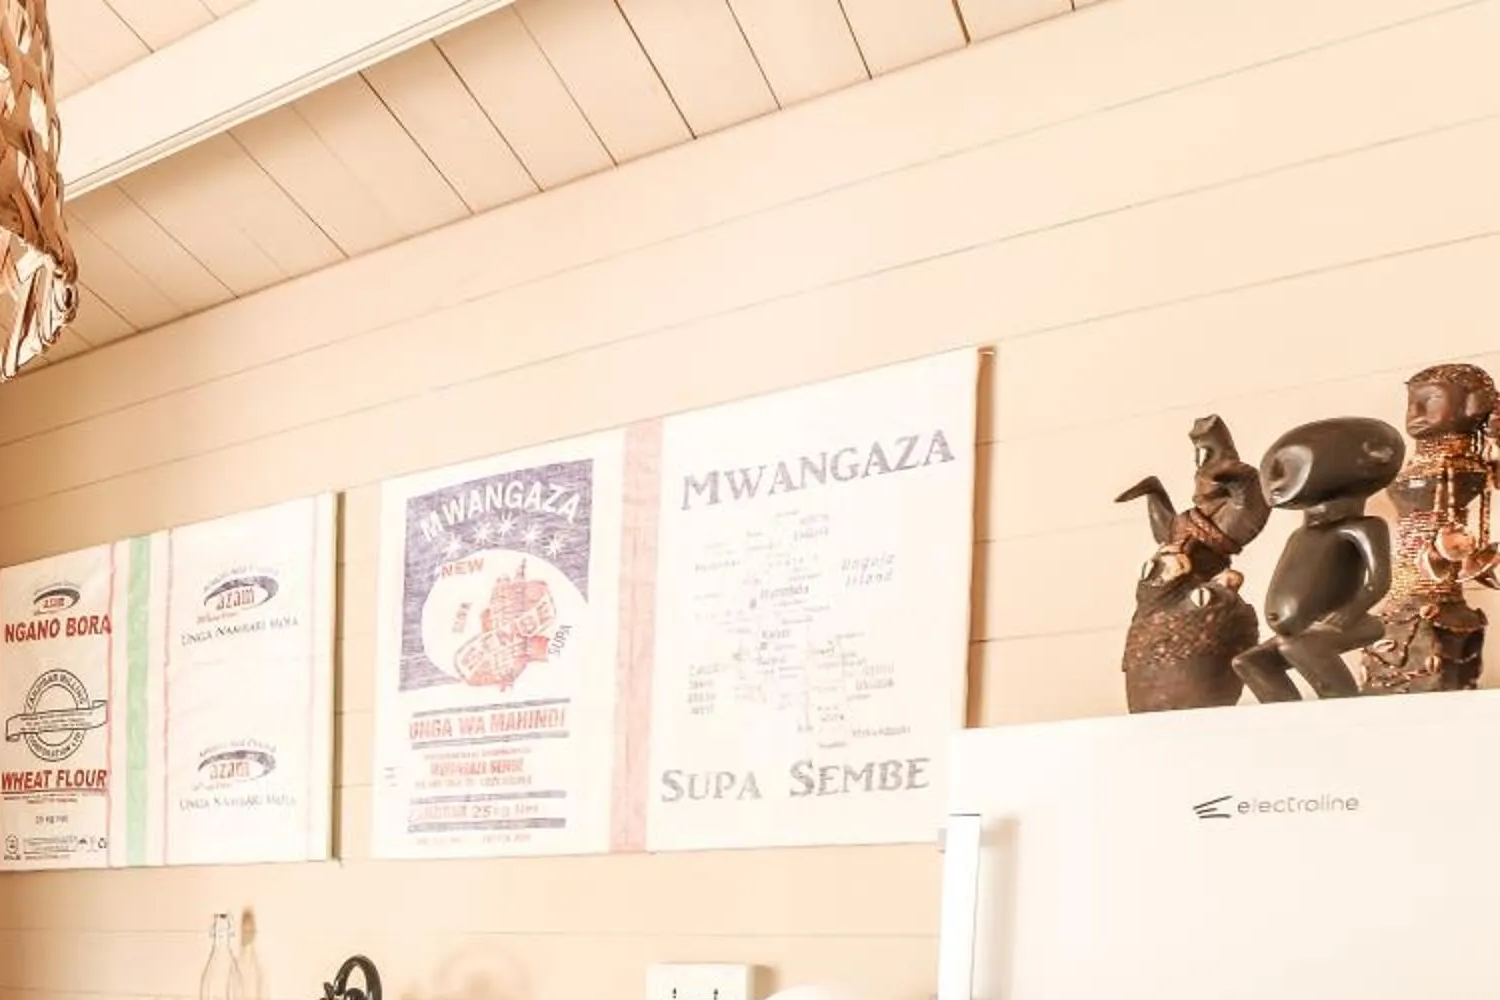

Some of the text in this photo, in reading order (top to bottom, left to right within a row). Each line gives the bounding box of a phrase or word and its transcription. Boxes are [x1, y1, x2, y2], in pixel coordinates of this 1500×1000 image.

[680, 429, 956, 511] MWANGAZA
[420, 480, 581, 542] MWANGAZA
[441, 558, 485, 579] NEW
[4, 614, 112, 644] NGANO BORA
[1, 769, 107, 790] WHEAT FLOUR
[660, 757, 931, 802] SUPA SEMBE
[1237, 793, 1360, 814] electroline
